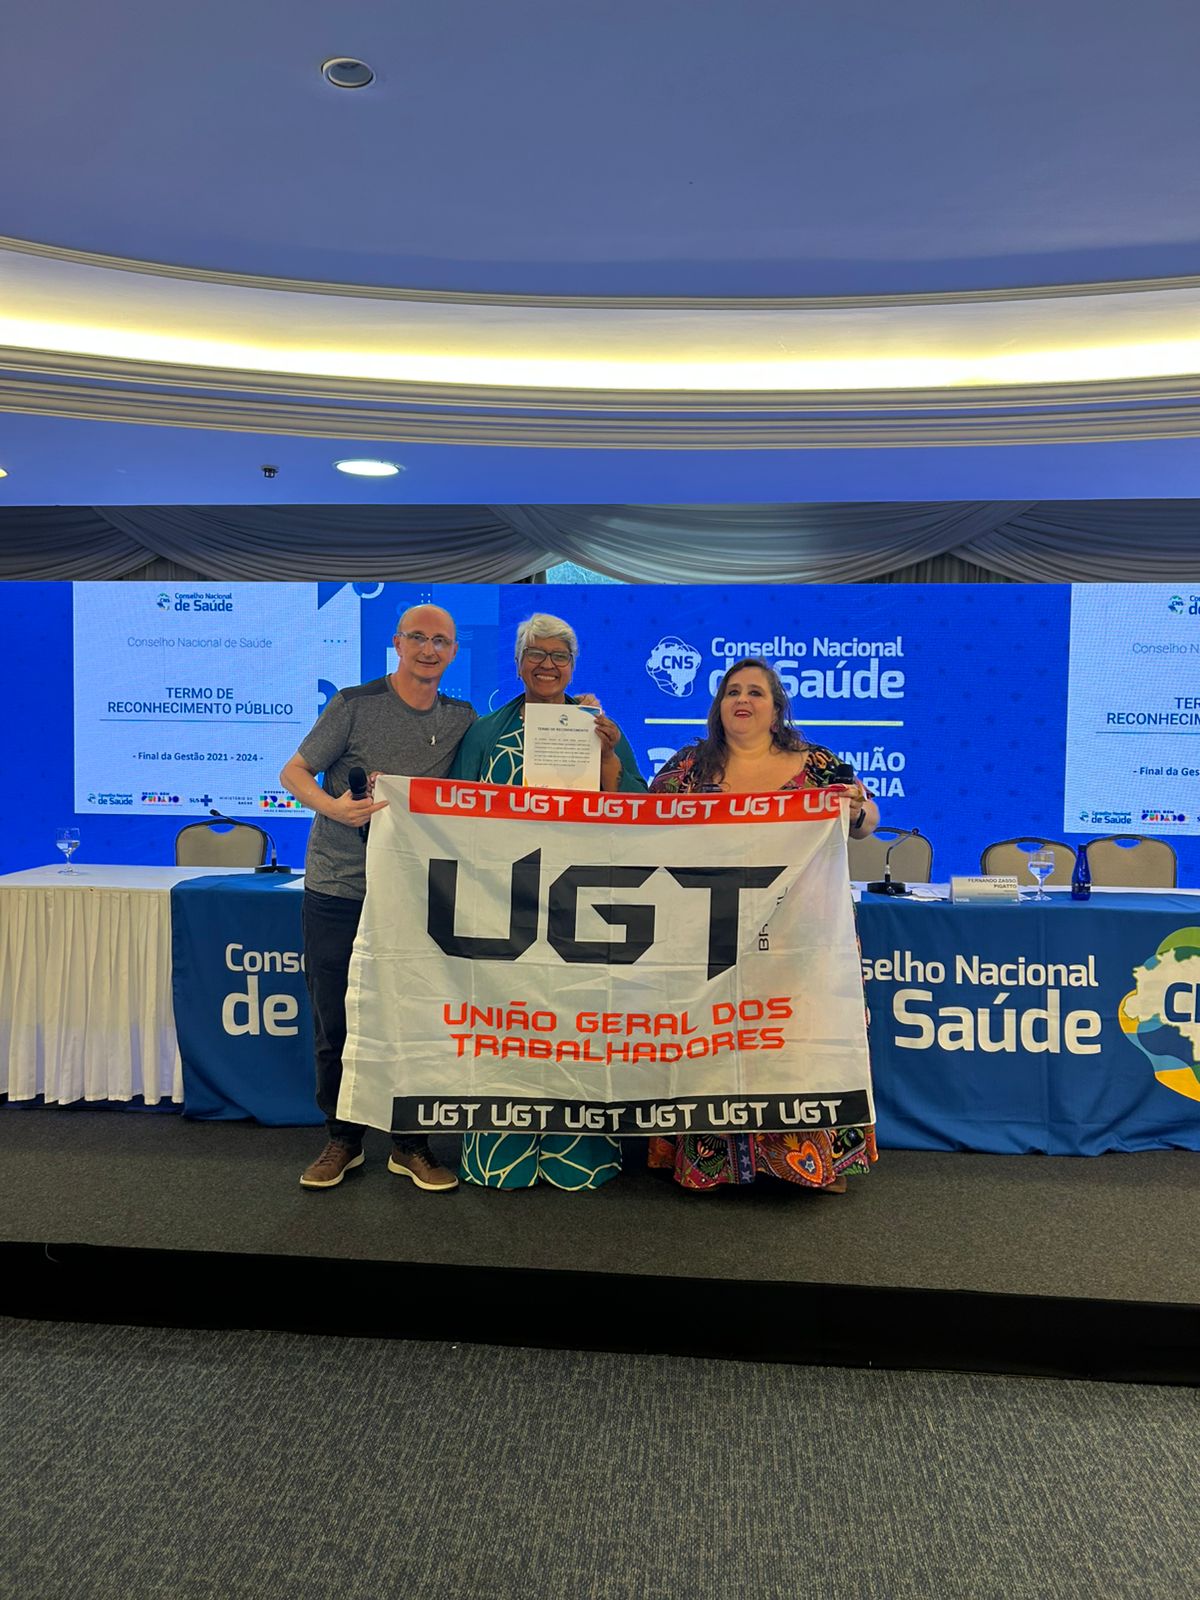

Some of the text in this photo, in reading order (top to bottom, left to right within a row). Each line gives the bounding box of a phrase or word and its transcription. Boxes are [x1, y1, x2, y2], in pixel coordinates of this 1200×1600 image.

[174, 592, 233, 600] Conselho Nacional
[174, 599, 233, 612] de Saúde
[127, 636, 273, 649] Conselho Nacional de Saúde
[711, 636, 904, 657] Conselho Nacional
[1132, 642, 1188, 654] Conselho
[661, 655, 694, 670] CNS
[773, 658, 905, 699] Saúde
[165, 687, 234, 700] TERMO DE
[107, 700, 293, 715] RECONHECIMENTO PÚBLICO
[1106, 712, 1200, 726] RECONHECI
[138, 752, 159, 761] Final
[161, 752, 172, 761] da
[174, 751, 205, 761] Gestão
[207, 752, 228, 761] 2021
[236, 753, 258, 762] 2024
[1140, 766, 1163, 776] Final
[1166, 767, 1178, 776] da
[1181, 767, 1200, 776] Ges
[862, 776, 905, 797] RIA
[435, 785, 840, 820] UGT UGT UGT UGT UGT UG
[427, 847, 788, 981] UGT
[225, 943, 305, 973] Cons
[861, 950, 1099, 987] selho Nacional
[222, 975, 299, 1036] de
[443, 997, 793, 1037] UNIÃO GERAL DOS
[892, 988, 1102, 1055] Saúde
[449, 1028, 786, 1066] TRABALHADORES
[417, 1098, 843, 1132] UGT UGT UGT UGT UGT UGT
